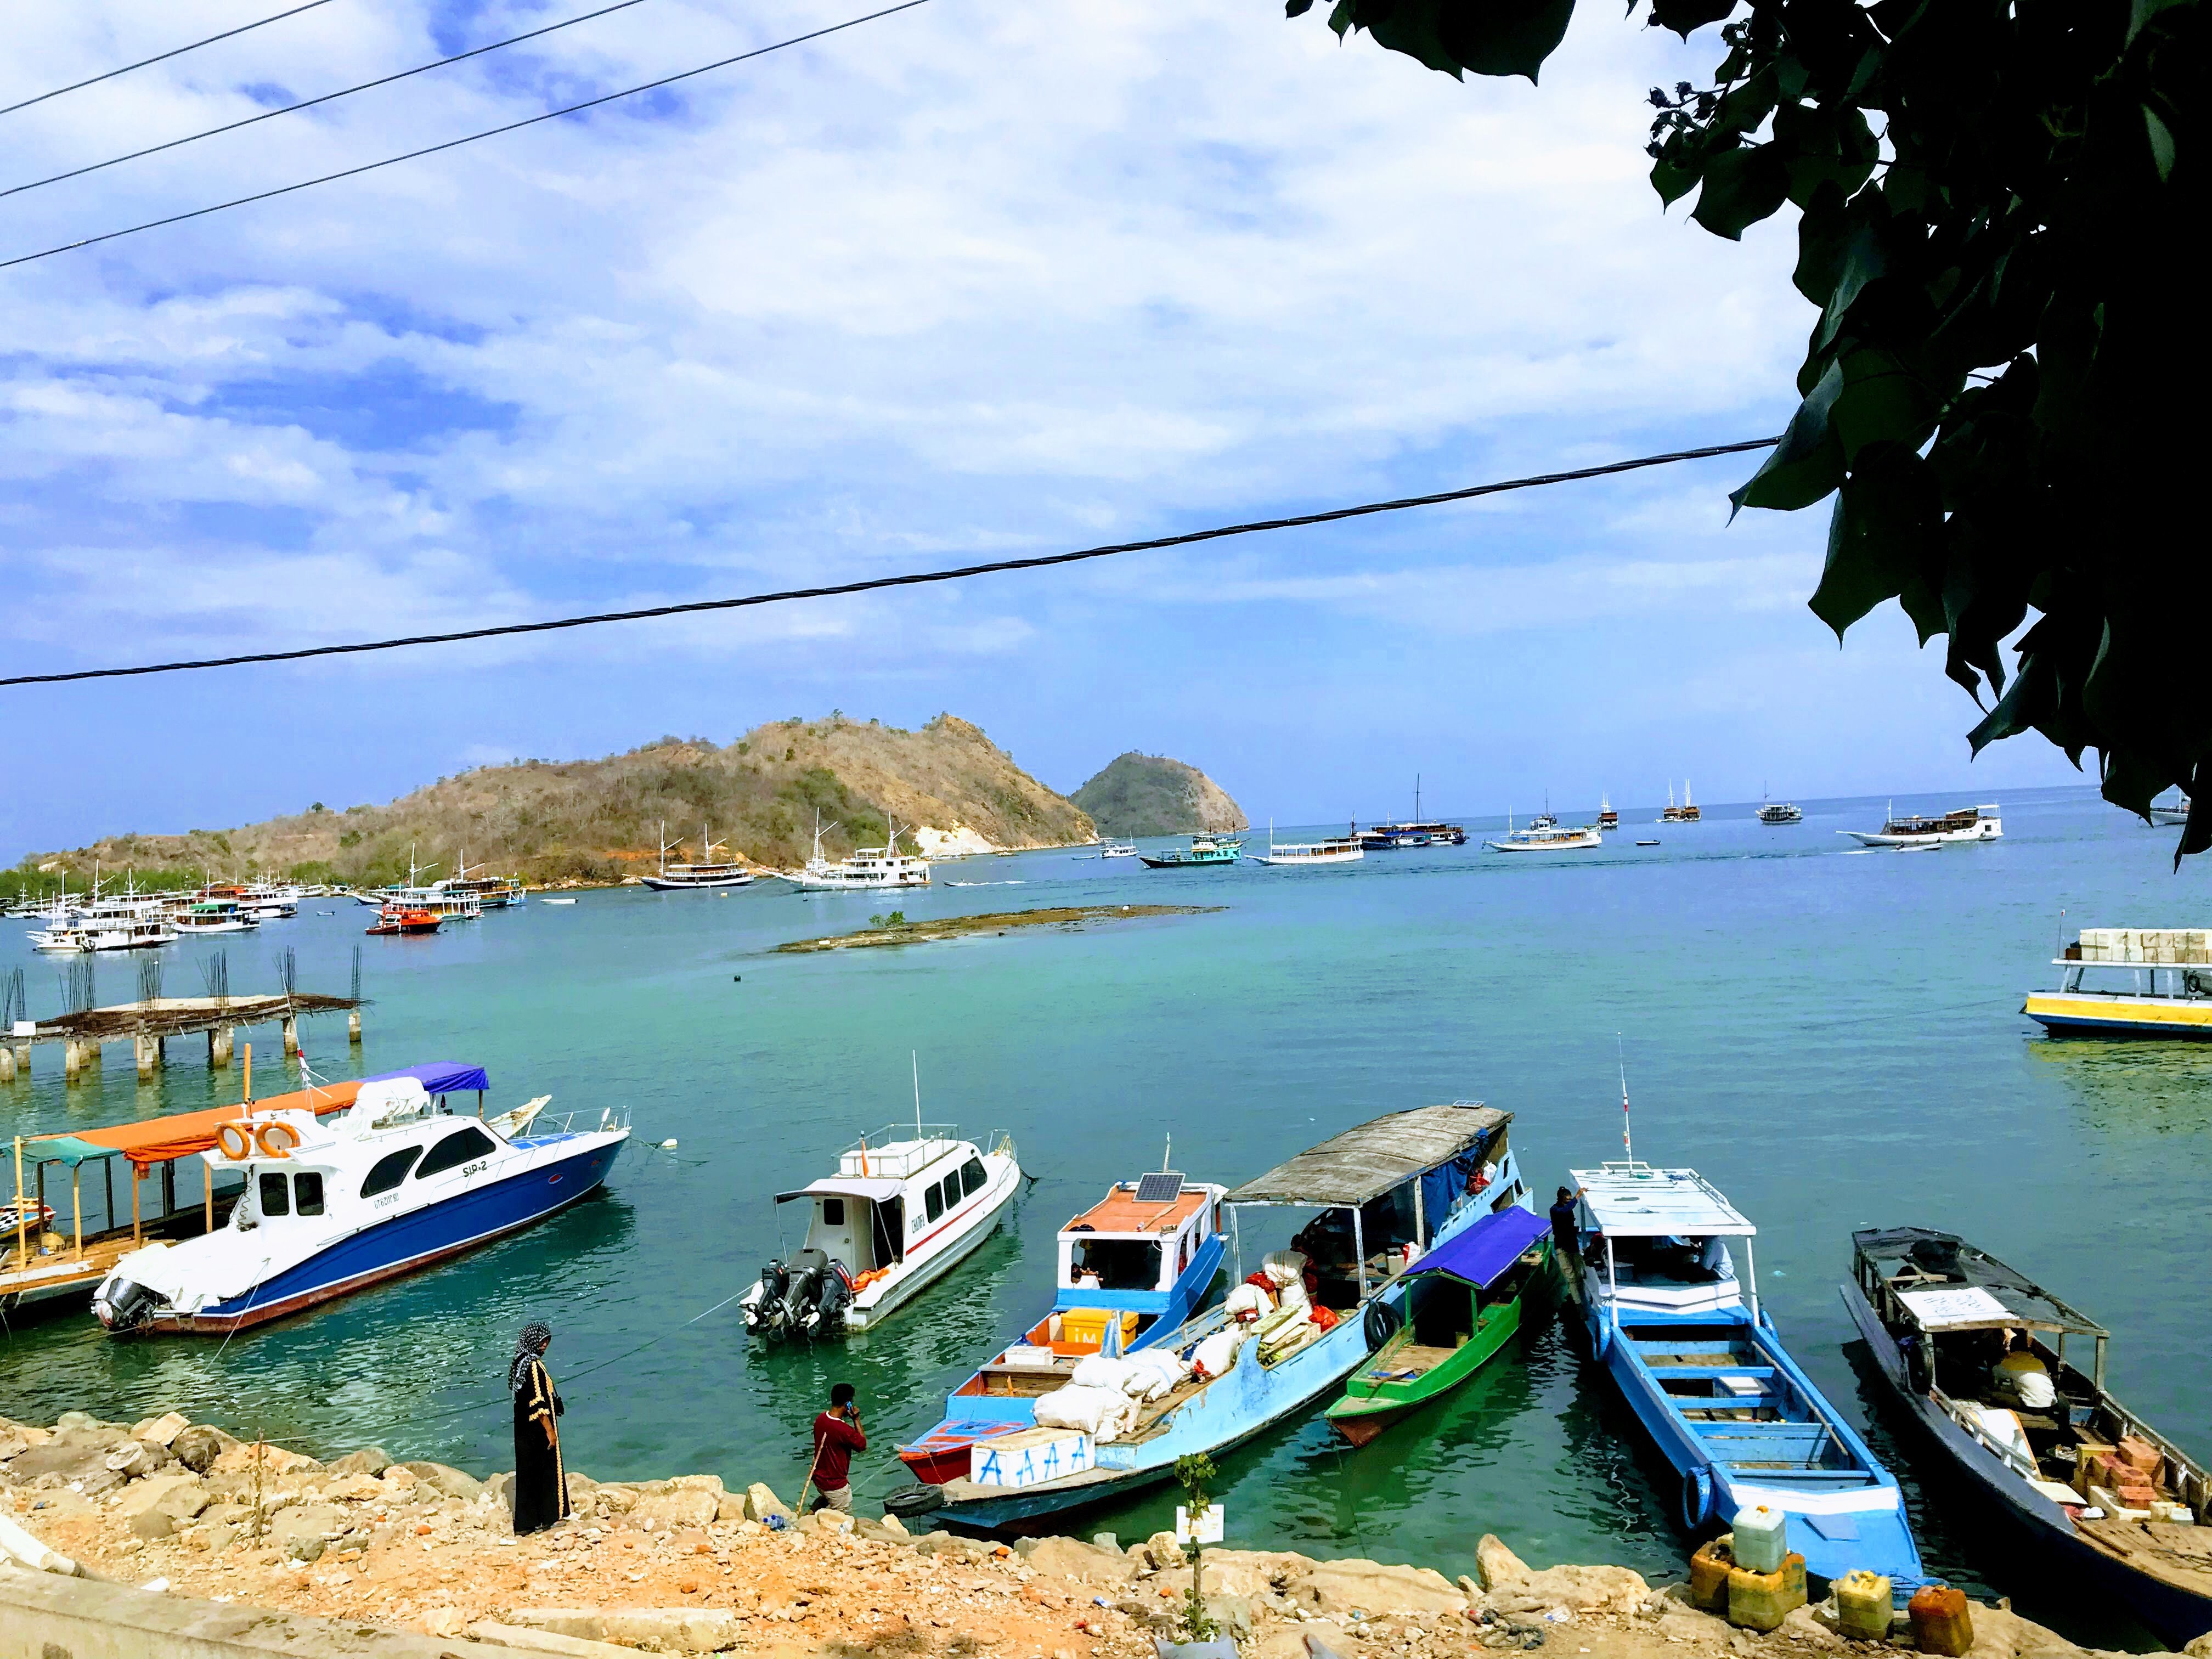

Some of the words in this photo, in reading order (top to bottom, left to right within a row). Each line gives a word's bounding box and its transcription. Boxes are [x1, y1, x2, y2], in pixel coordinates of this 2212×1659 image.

[978, 1449, 1003, 1486] A
[1016, 1448, 1035, 1486] A
[1044, 1442, 1060, 1480] A
[1071, 1436, 1086, 1470] A
